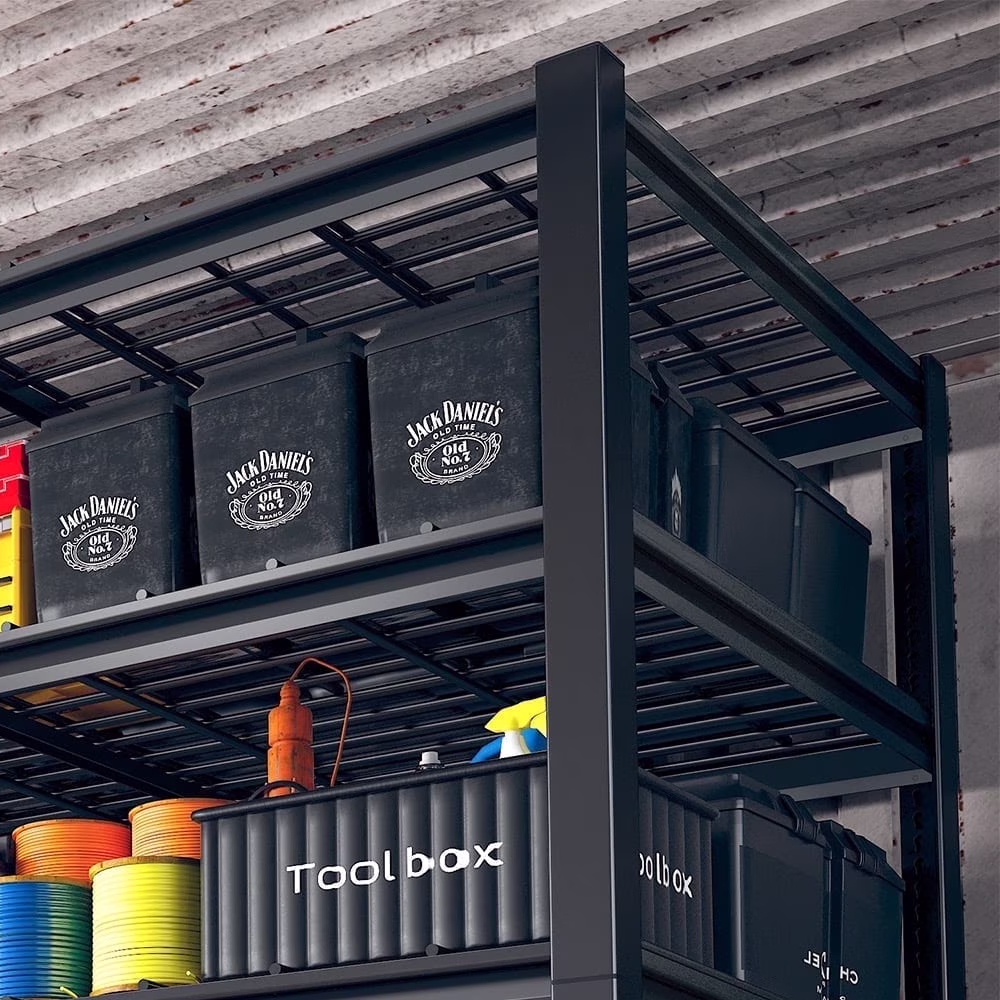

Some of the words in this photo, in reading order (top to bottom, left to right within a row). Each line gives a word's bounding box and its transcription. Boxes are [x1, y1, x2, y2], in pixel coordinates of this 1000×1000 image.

[406, 410, 443, 447] JACK
[443, 400, 503, 427] DANIEL'S
[432, 427, 451, 439] OLD
[454, 423, 476, 431] TIME
[442, 440, 467, 456] Old
[441, 451, 470, 467] No.7
[226, 459, 259, 494] JACK
[259, 449, 314, 475] DANIEL'S
[443, 464, 469, 474] BRAND
[250, 475, 266, 487] OLD
[258, 488, 281, 503] Old
[257, 498, 284, 513] No.7
[59, 504, 90, 537] JACK
[89, 495, 139, 520] DANIEL'S
[259, 511, 282, 520] BRAND
[81, 520, 96, 531] OLD
[89, 532, 110, 546] Old
[89, 554, 111, 562] BRAND
